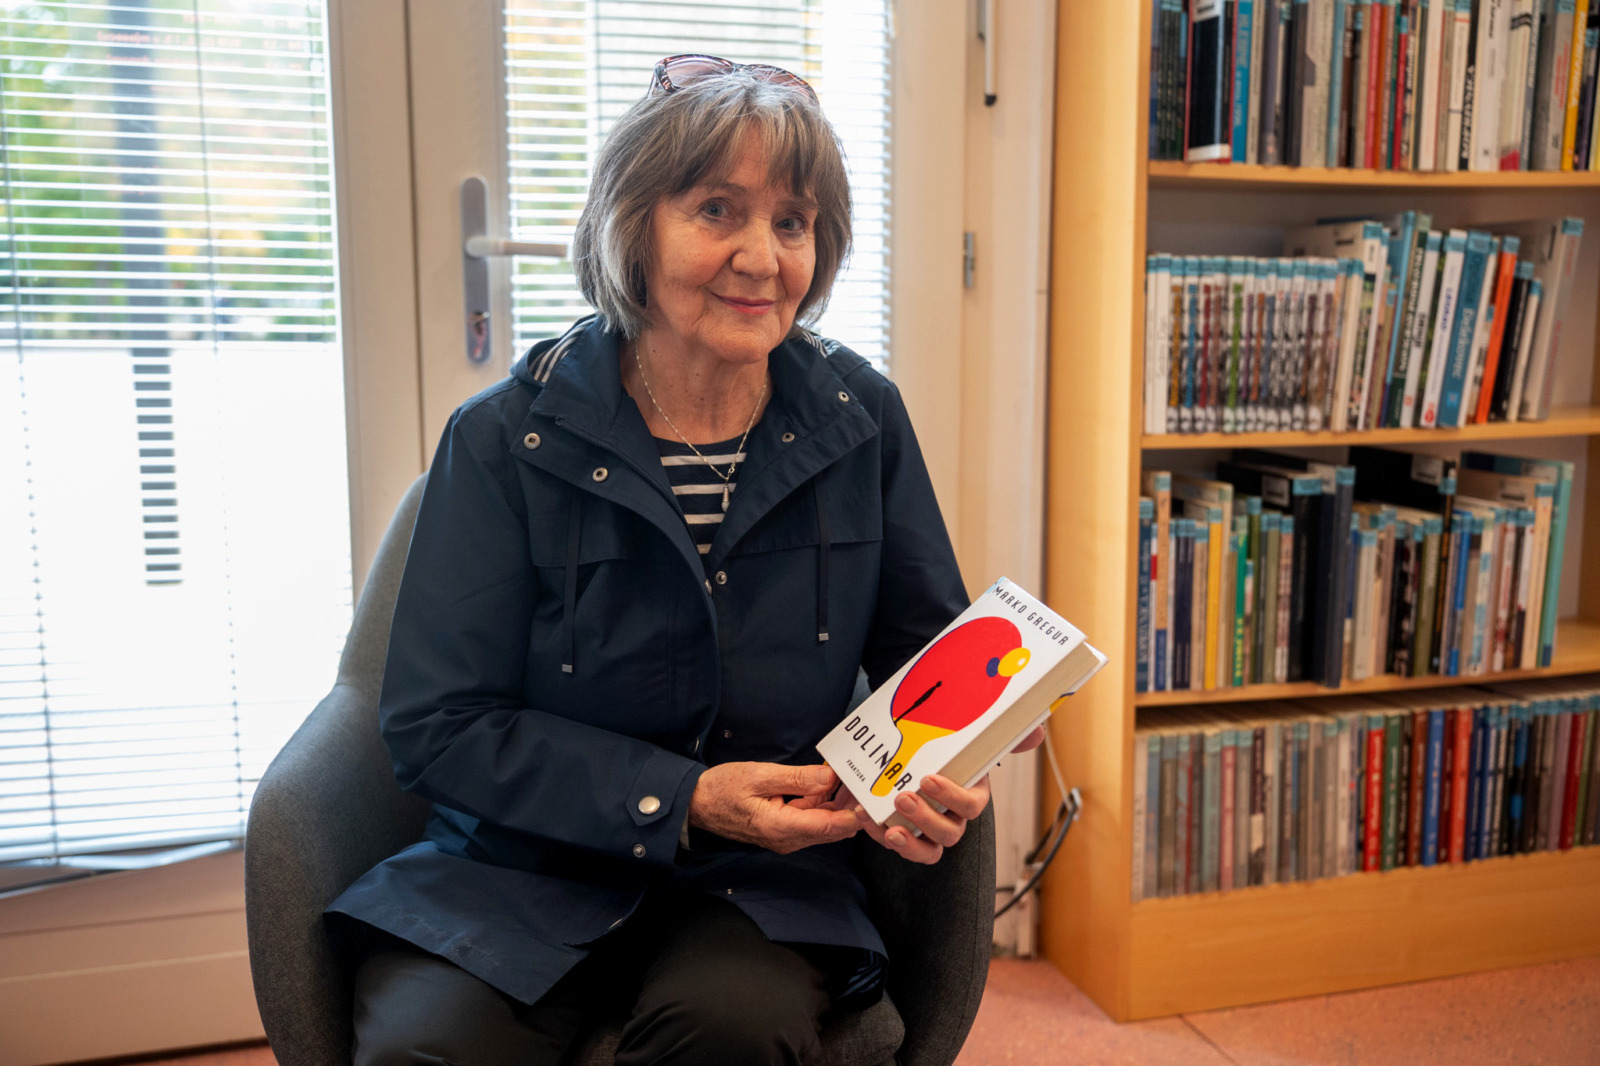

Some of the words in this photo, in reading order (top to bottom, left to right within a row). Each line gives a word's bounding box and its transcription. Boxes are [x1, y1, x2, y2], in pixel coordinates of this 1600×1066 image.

[992, 586, 1027, 613] MARKO
[1027, 612, 1069, 645] GREGUR
[844, 716, 913, 791] DOLINAR
[846, 759, 866, 782] FRAKTURA
